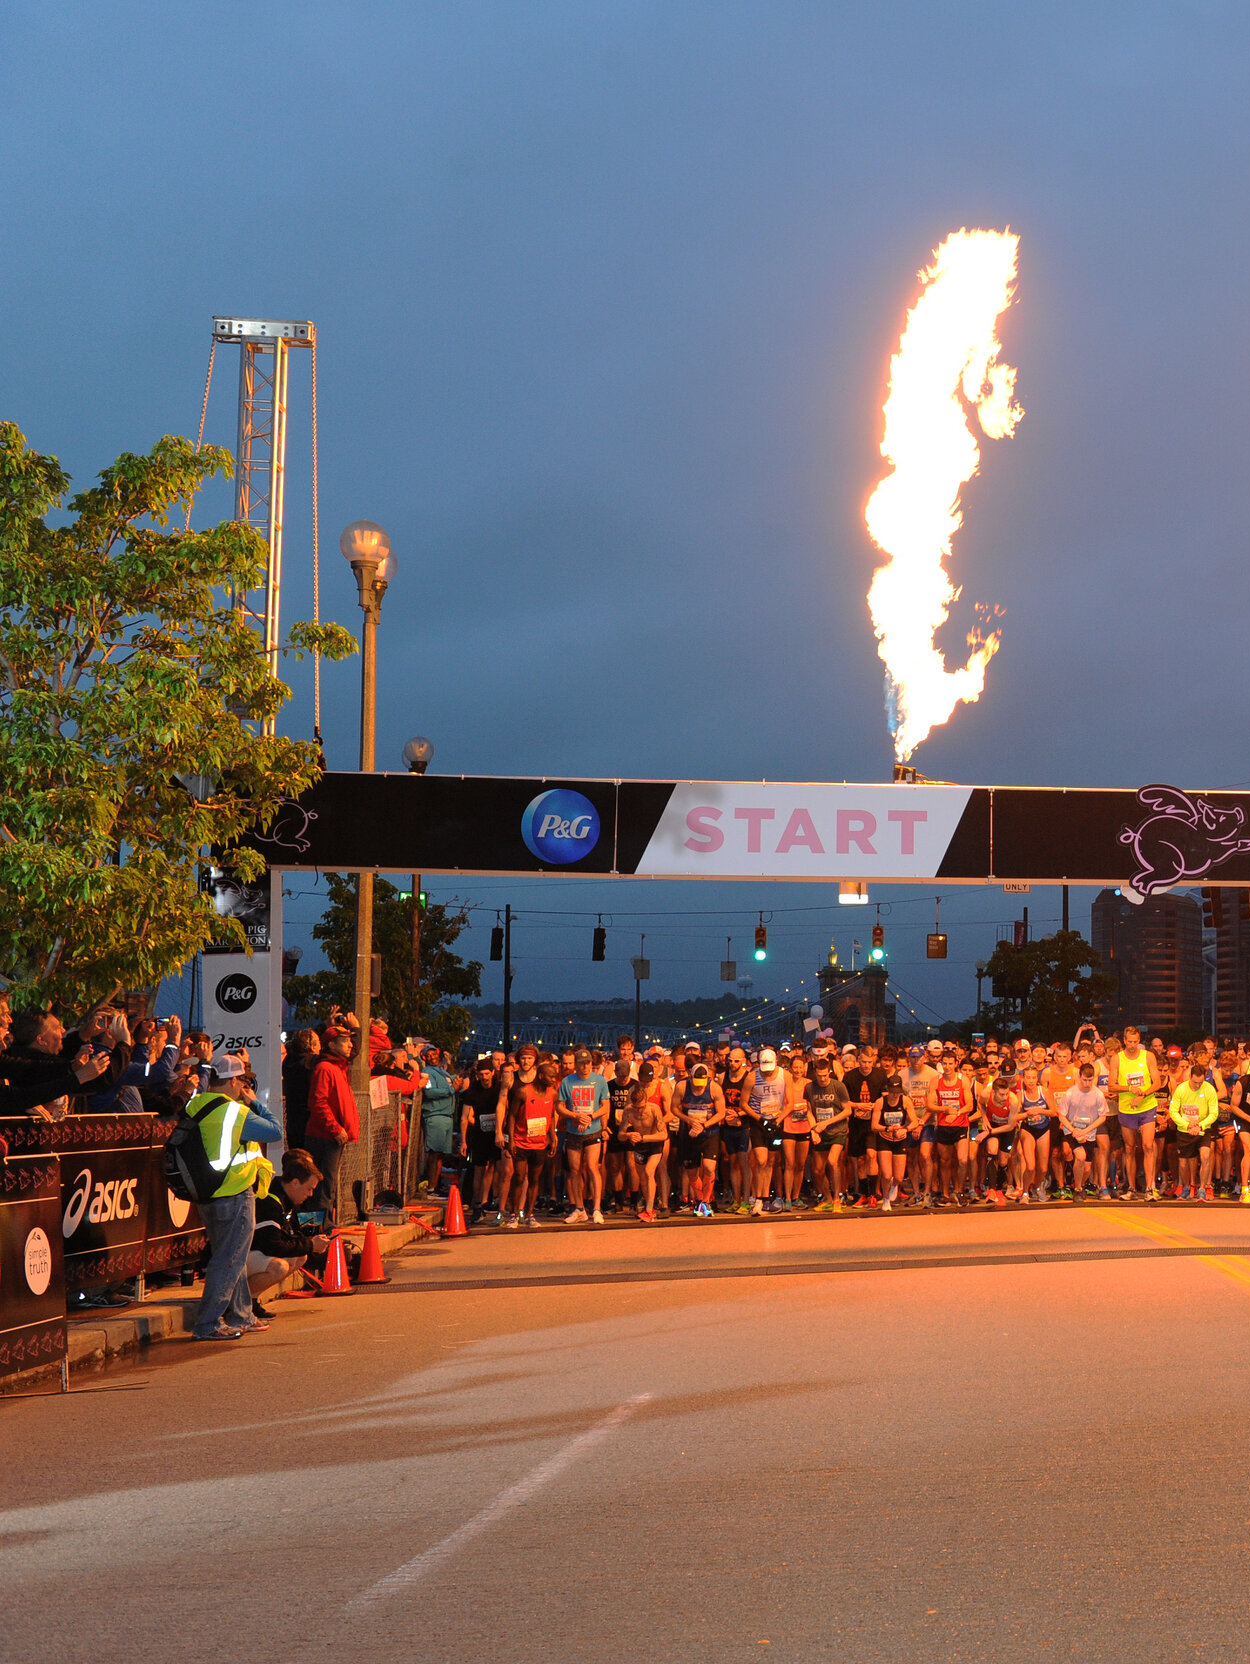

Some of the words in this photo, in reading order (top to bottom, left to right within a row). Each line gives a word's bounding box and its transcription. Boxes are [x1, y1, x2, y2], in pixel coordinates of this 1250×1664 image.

[537, 814, 592, 839] P&G
[684, 806, 928, 855] START
[248, 925, 267, 934] PIG
[224, 986, 253, 1000] P&G
[28, 1248, 48, 1260] simple
[30, 1261, 49, 1276] truth
